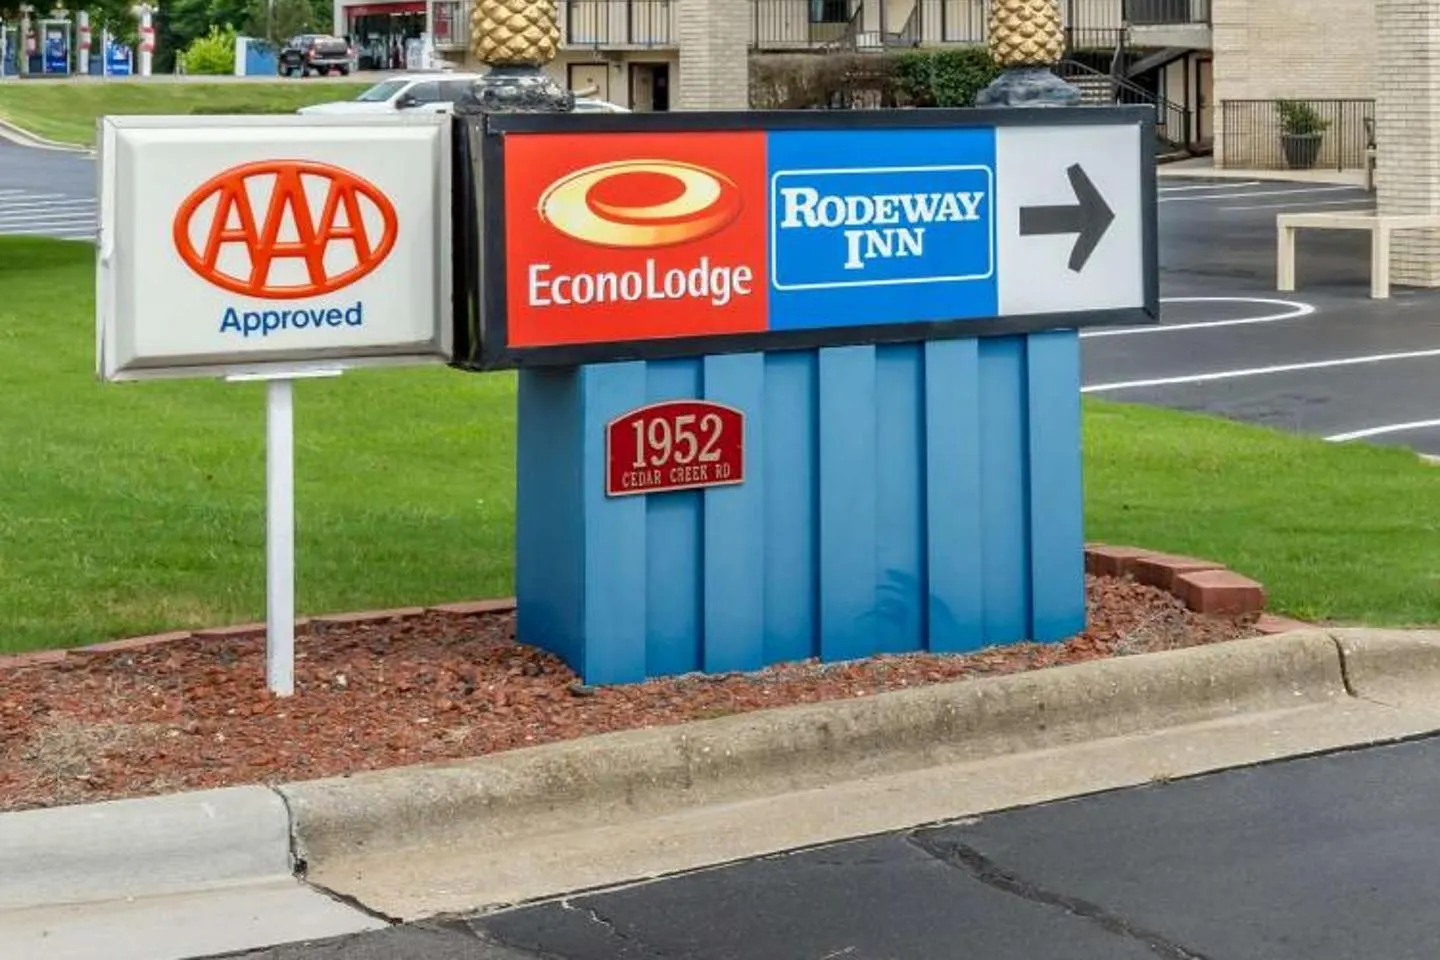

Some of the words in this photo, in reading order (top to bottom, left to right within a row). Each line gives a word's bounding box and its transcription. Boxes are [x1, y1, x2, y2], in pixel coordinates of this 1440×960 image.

[200, 161, 373, 294] AAA
[779, 187, 985, 229] RODEWAY
[844, 227, 925, 270] INN
[527, 256, 753, 307] EconoLodge
[219, 301, 363, 338] Approved
[632, 414, 722, 467] 1952
[622, 471, 662, 488] CEDAR
[670, 465, 708, 483] CREEK
[716, 463, 731, 479] RD
